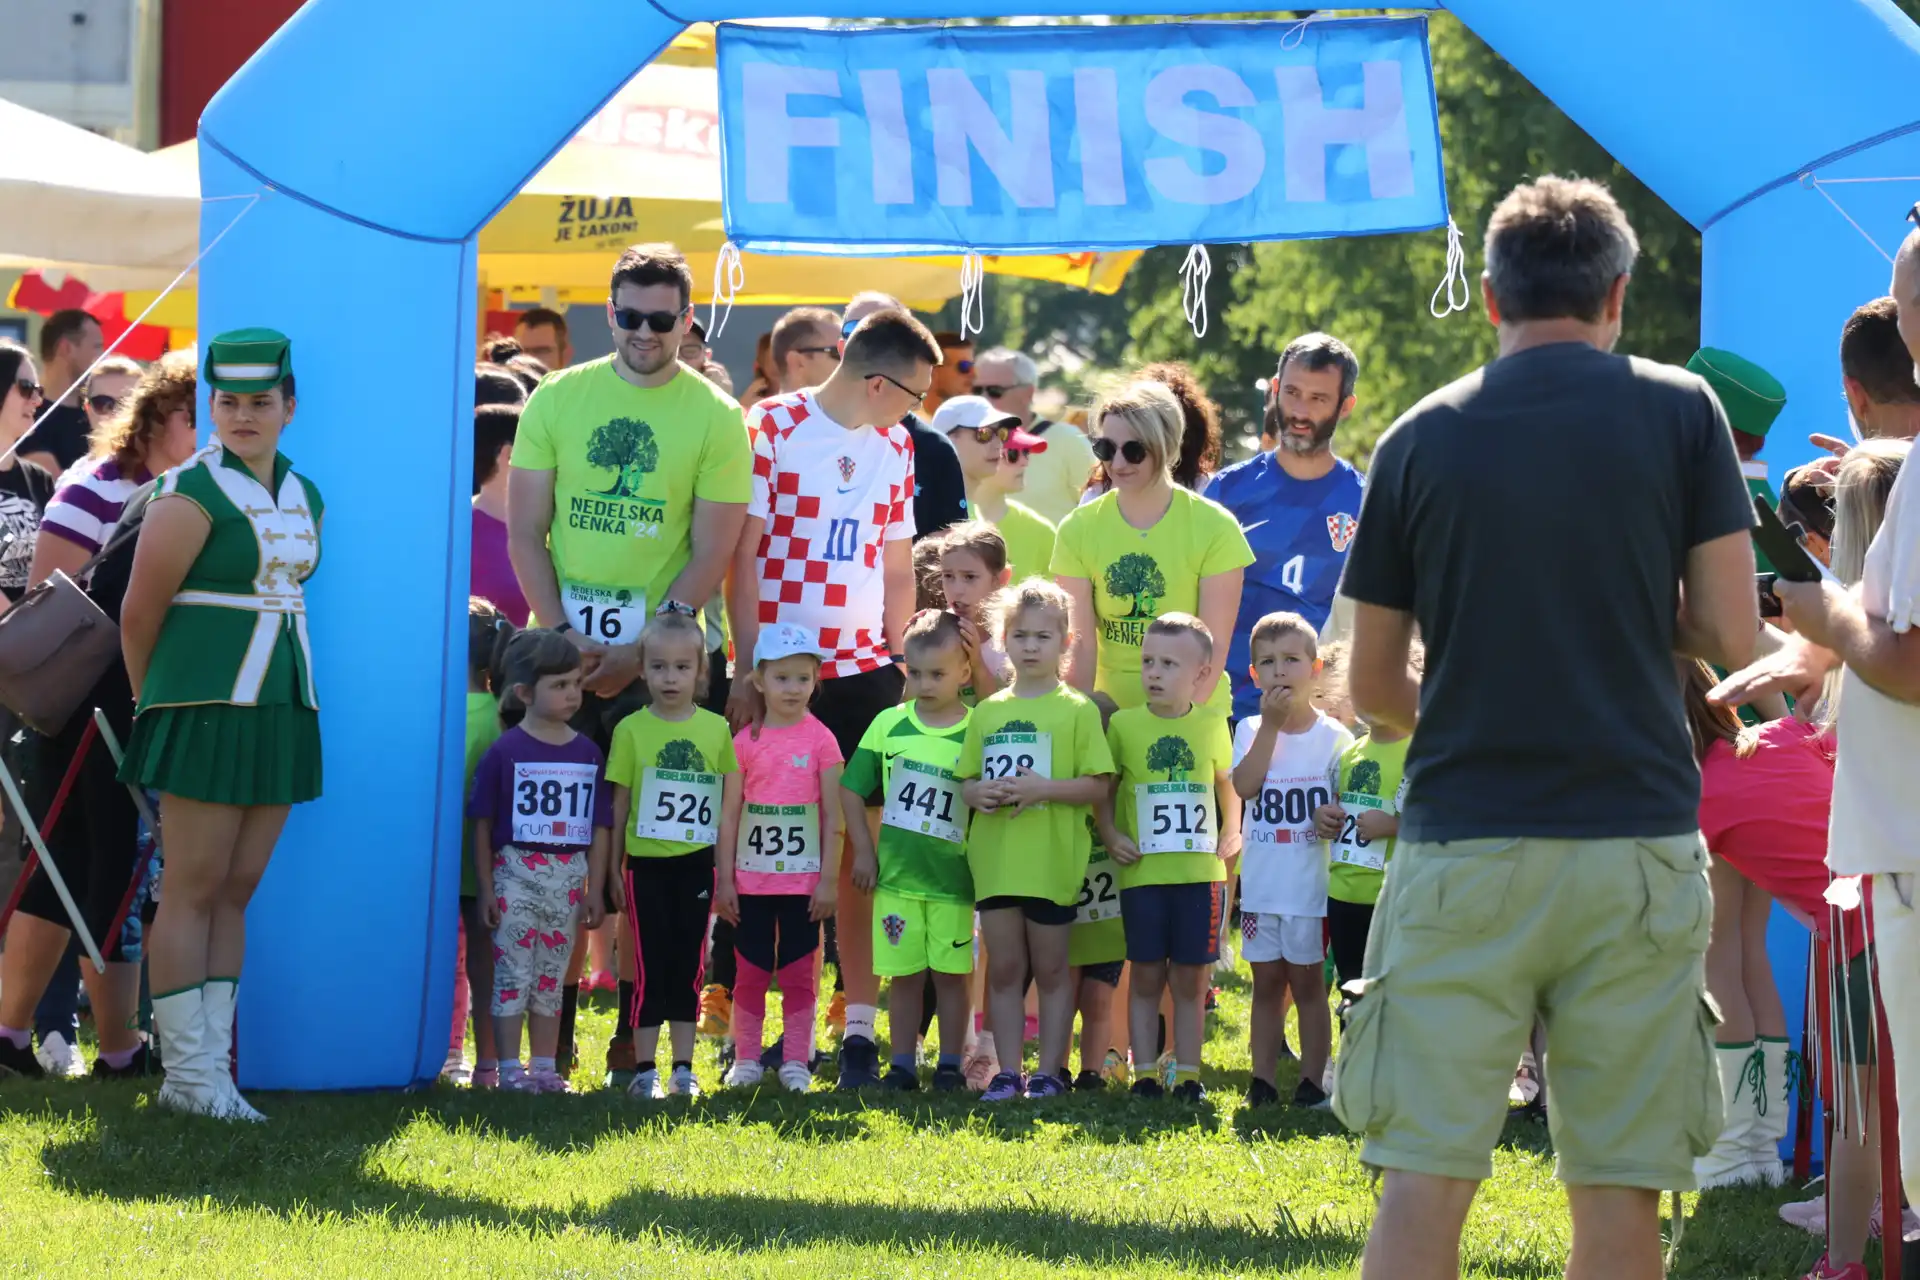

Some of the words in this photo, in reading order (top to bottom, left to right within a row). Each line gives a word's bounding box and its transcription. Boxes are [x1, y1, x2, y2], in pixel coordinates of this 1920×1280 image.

[743, 60, 1414, 208] FINISH
[559, 195, 634, 223] ŽUJA
[554, 226, 571, 243] JE
[569, 513, 626, 535] CENKA
[570, 497, 664, 523] NEDELSKA
[823, 518, 860, 561] 10
[570, 591, 594, 603] CENKA
[571, 585, 612, 597] NEDELSKA
[579, 605, 621, 638] 16
[1103, 619, 1146, 635] NEDEL
[517, 780, 592, 818] 3817
[655, 791, 711, 825] 526
[898, 782, 953, 822] 441
[520, 823, 552, 836] run
[1153, 804, 1208, 835] 512
[748, 826, 805, 856] 435
